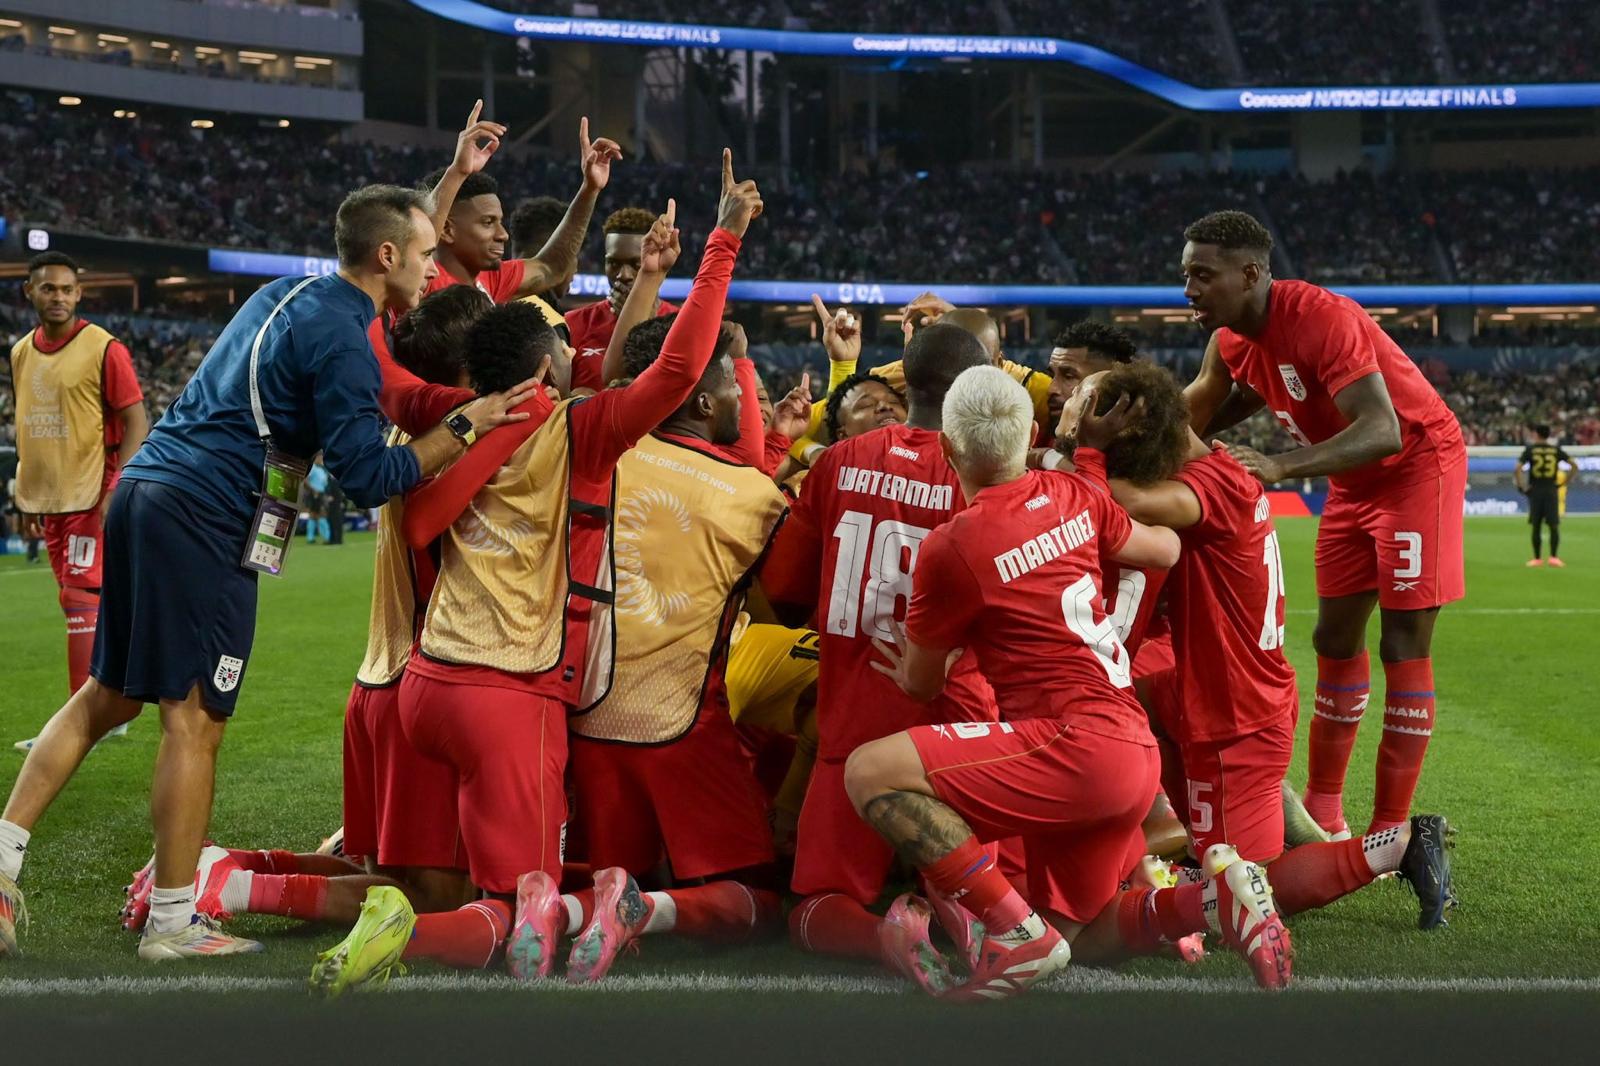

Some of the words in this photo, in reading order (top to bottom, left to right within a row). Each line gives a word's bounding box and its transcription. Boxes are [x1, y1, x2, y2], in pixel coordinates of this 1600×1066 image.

[571, 22, 620, 37] NATIONS
[621, 24, 665, 40] LEAGUE
[666, 28, 720, 43] FINALS
[909, 38, 956, 52] NATIONS
[958, 39, 1002, 53] LEAGUE
[1003, 39, 1057, 54] FINALS
[1240, 91, 1313, 108] Concacaf
[1314, 90, 1380, 107] NATIONS
[1381, 89, 1440, 107] LEAGUE
[1442, 88, 1516, 106] FINALS
[31, 426, 69, 438] LEAGUE
[634, 451, 656, 463] THE
[656, 457, 697, 476] DREAM
[697, 470, 711, 481] IS
[710, 477, 736, 495] NOW
[1532, 454, 1557, 478] 23
[837, 466, 953, 510] WATERMAN
[67, 534, 97, 568] 10
[993, 509, 1095, 584] MARTÍNEZ
[1393, 531, 1423, 578] 3
[826, 510, 932, 644] 18
[1060, 572, 1132, 689] 6
